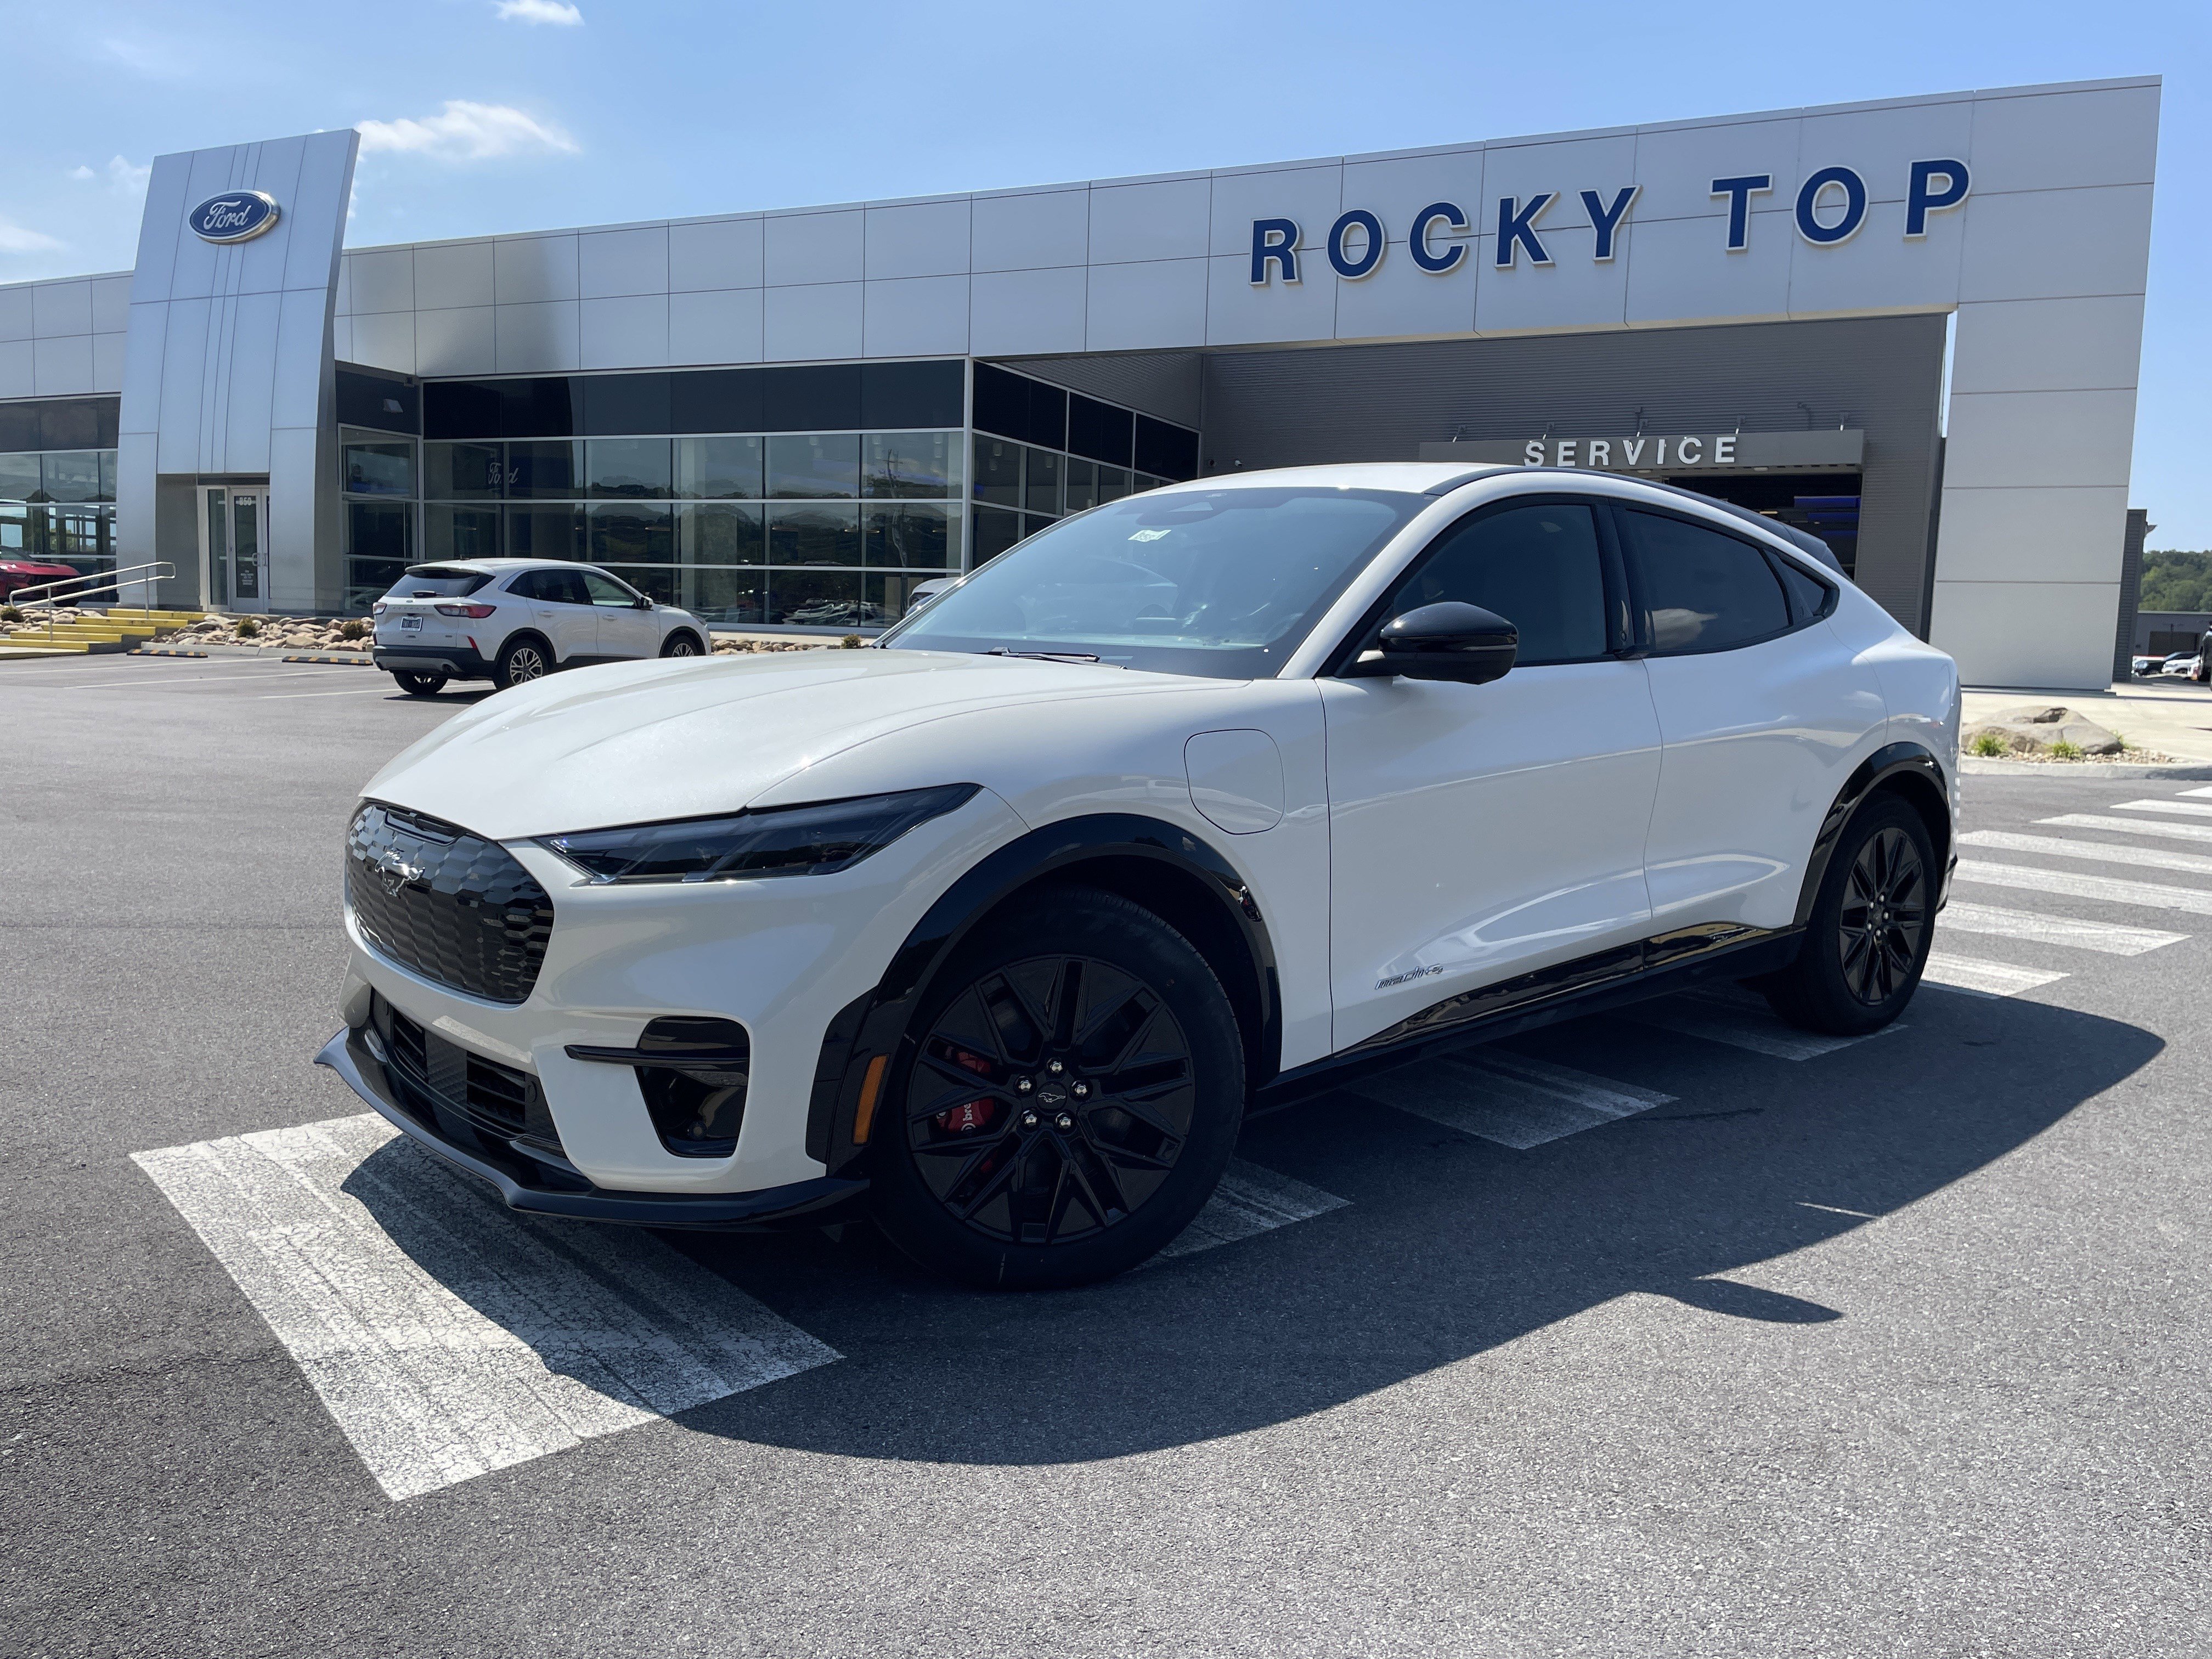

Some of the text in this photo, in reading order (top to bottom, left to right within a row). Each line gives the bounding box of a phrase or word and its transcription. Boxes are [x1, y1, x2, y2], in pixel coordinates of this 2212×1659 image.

[204, 200, 252, 230] Ford
[1249, 158, 1972, 285] ROCKY TOP
[1524, 437, 1737, 467] SERVICE
[488, 462, 519, 484] Fod
[962, 1103, 973, 1121] bre
